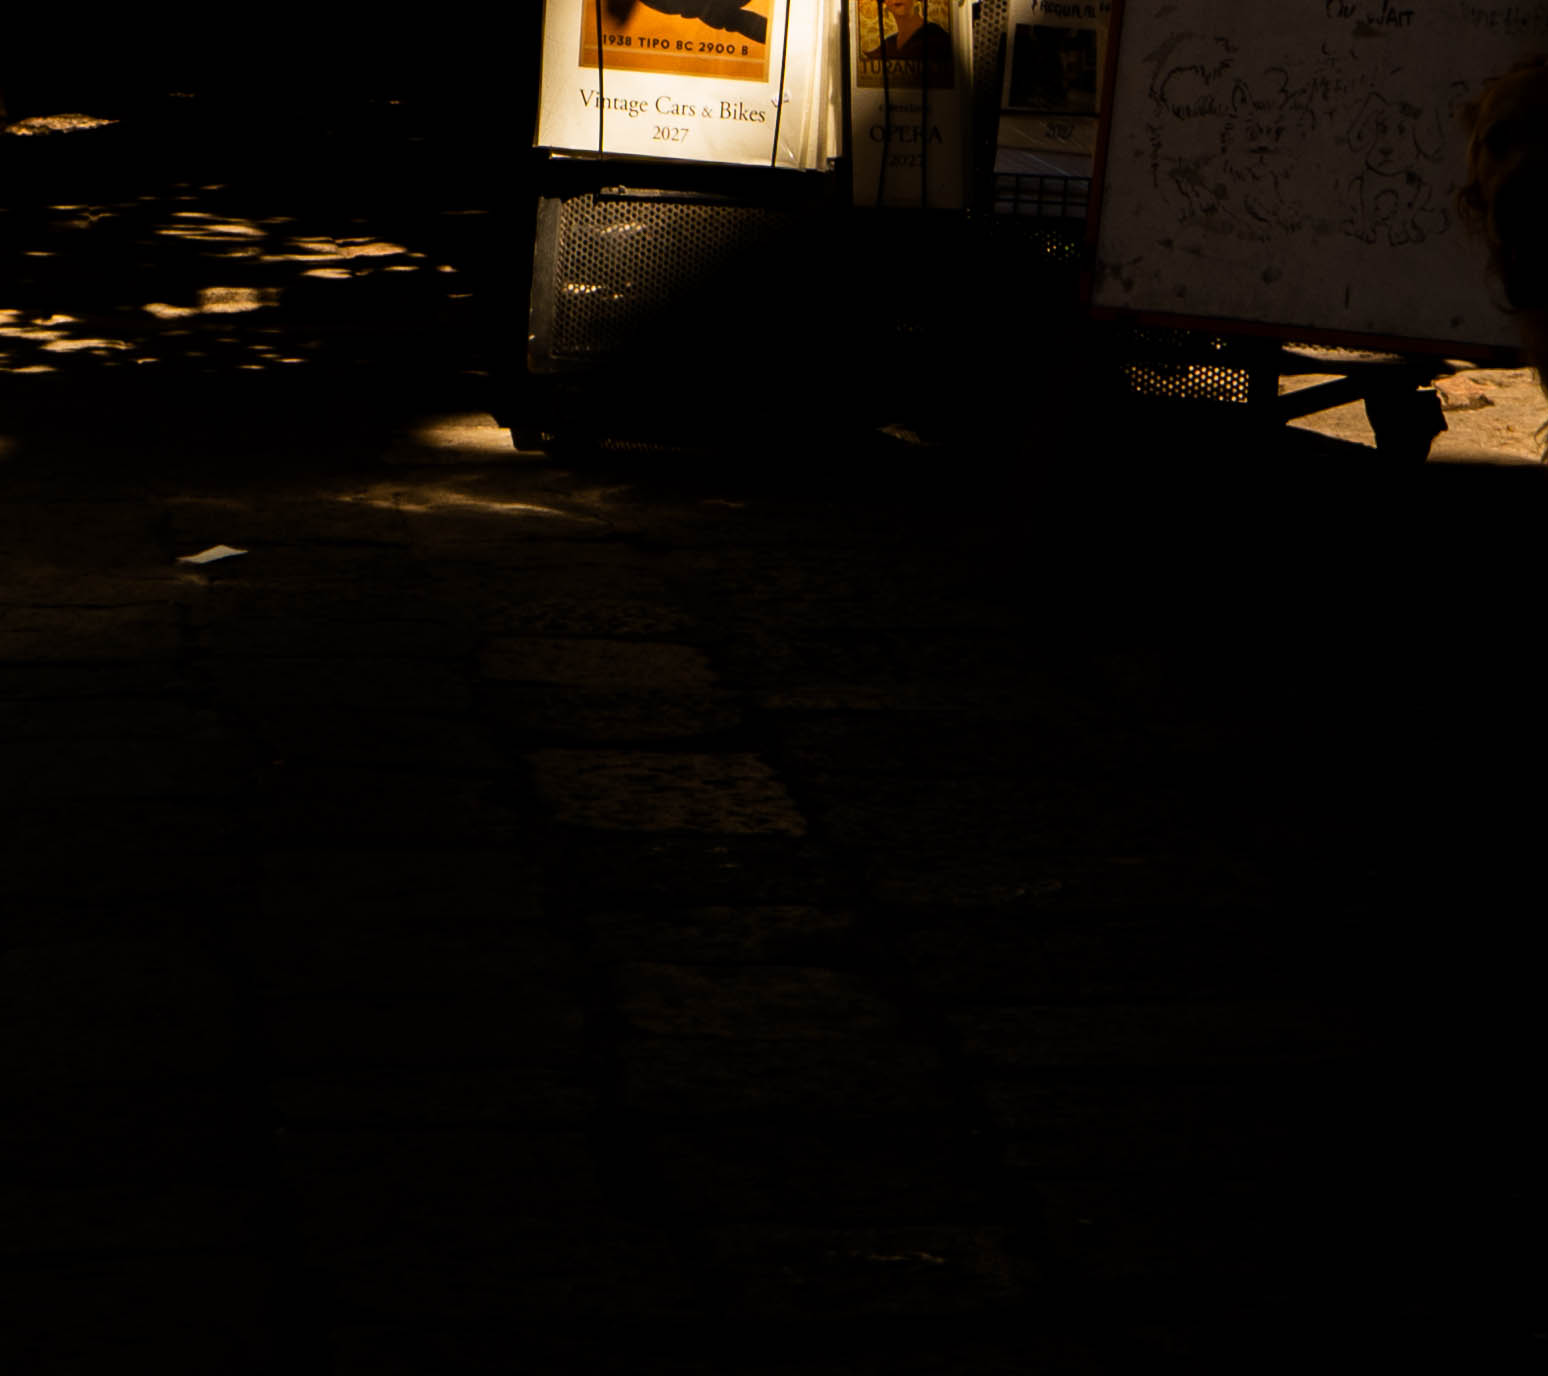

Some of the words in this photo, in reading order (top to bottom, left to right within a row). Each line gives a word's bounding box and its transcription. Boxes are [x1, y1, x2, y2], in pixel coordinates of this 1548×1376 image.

[602, 34, 633, 47] 1938
[639, 36, 671, 49] TIPO
[698, 41, 736, 55] 2900
[741, 45, 749, 56] B
[578, 89, 650, 117] Vintage
[655, 96, 699, 117] Cars
[703, 103, 717, 118] &
[719, 100, 767, 125] Bikes
[651, 124, 690, 144] 2027
